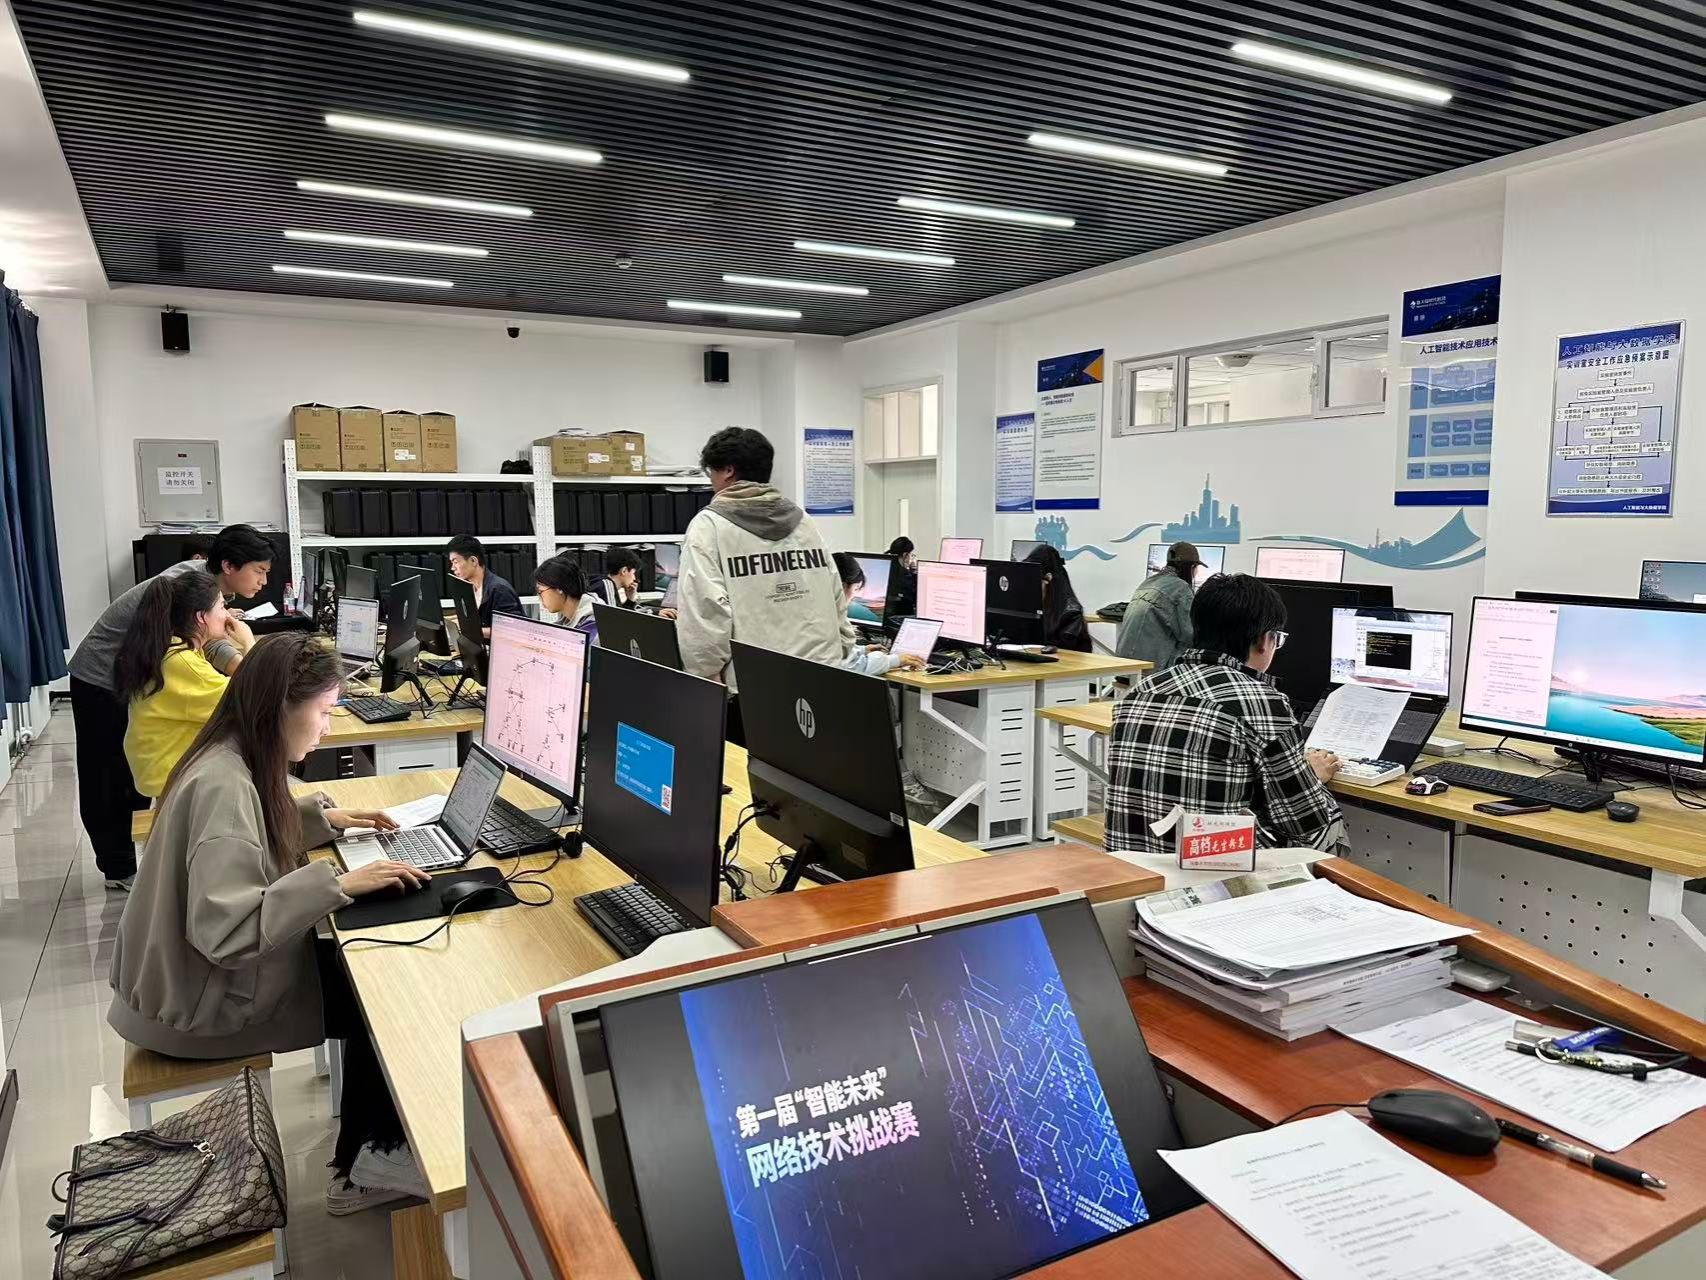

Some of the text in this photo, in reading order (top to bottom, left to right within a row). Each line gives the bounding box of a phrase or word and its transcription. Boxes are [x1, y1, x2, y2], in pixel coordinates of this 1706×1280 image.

[1419, 336, 1498, 355] 人工智能技术应用技术
[1561, 333, 1677, 356] 人工智能与大数据学院
[1566, 349, 1670, 370] 实训室安全工作应急预案示意图
[795, 697, 816, 739] hp
[735, 1066, 888, 1138] 第一届“智能未来”
[746, 1100, 920, 1188] 网络技术挑战赛
